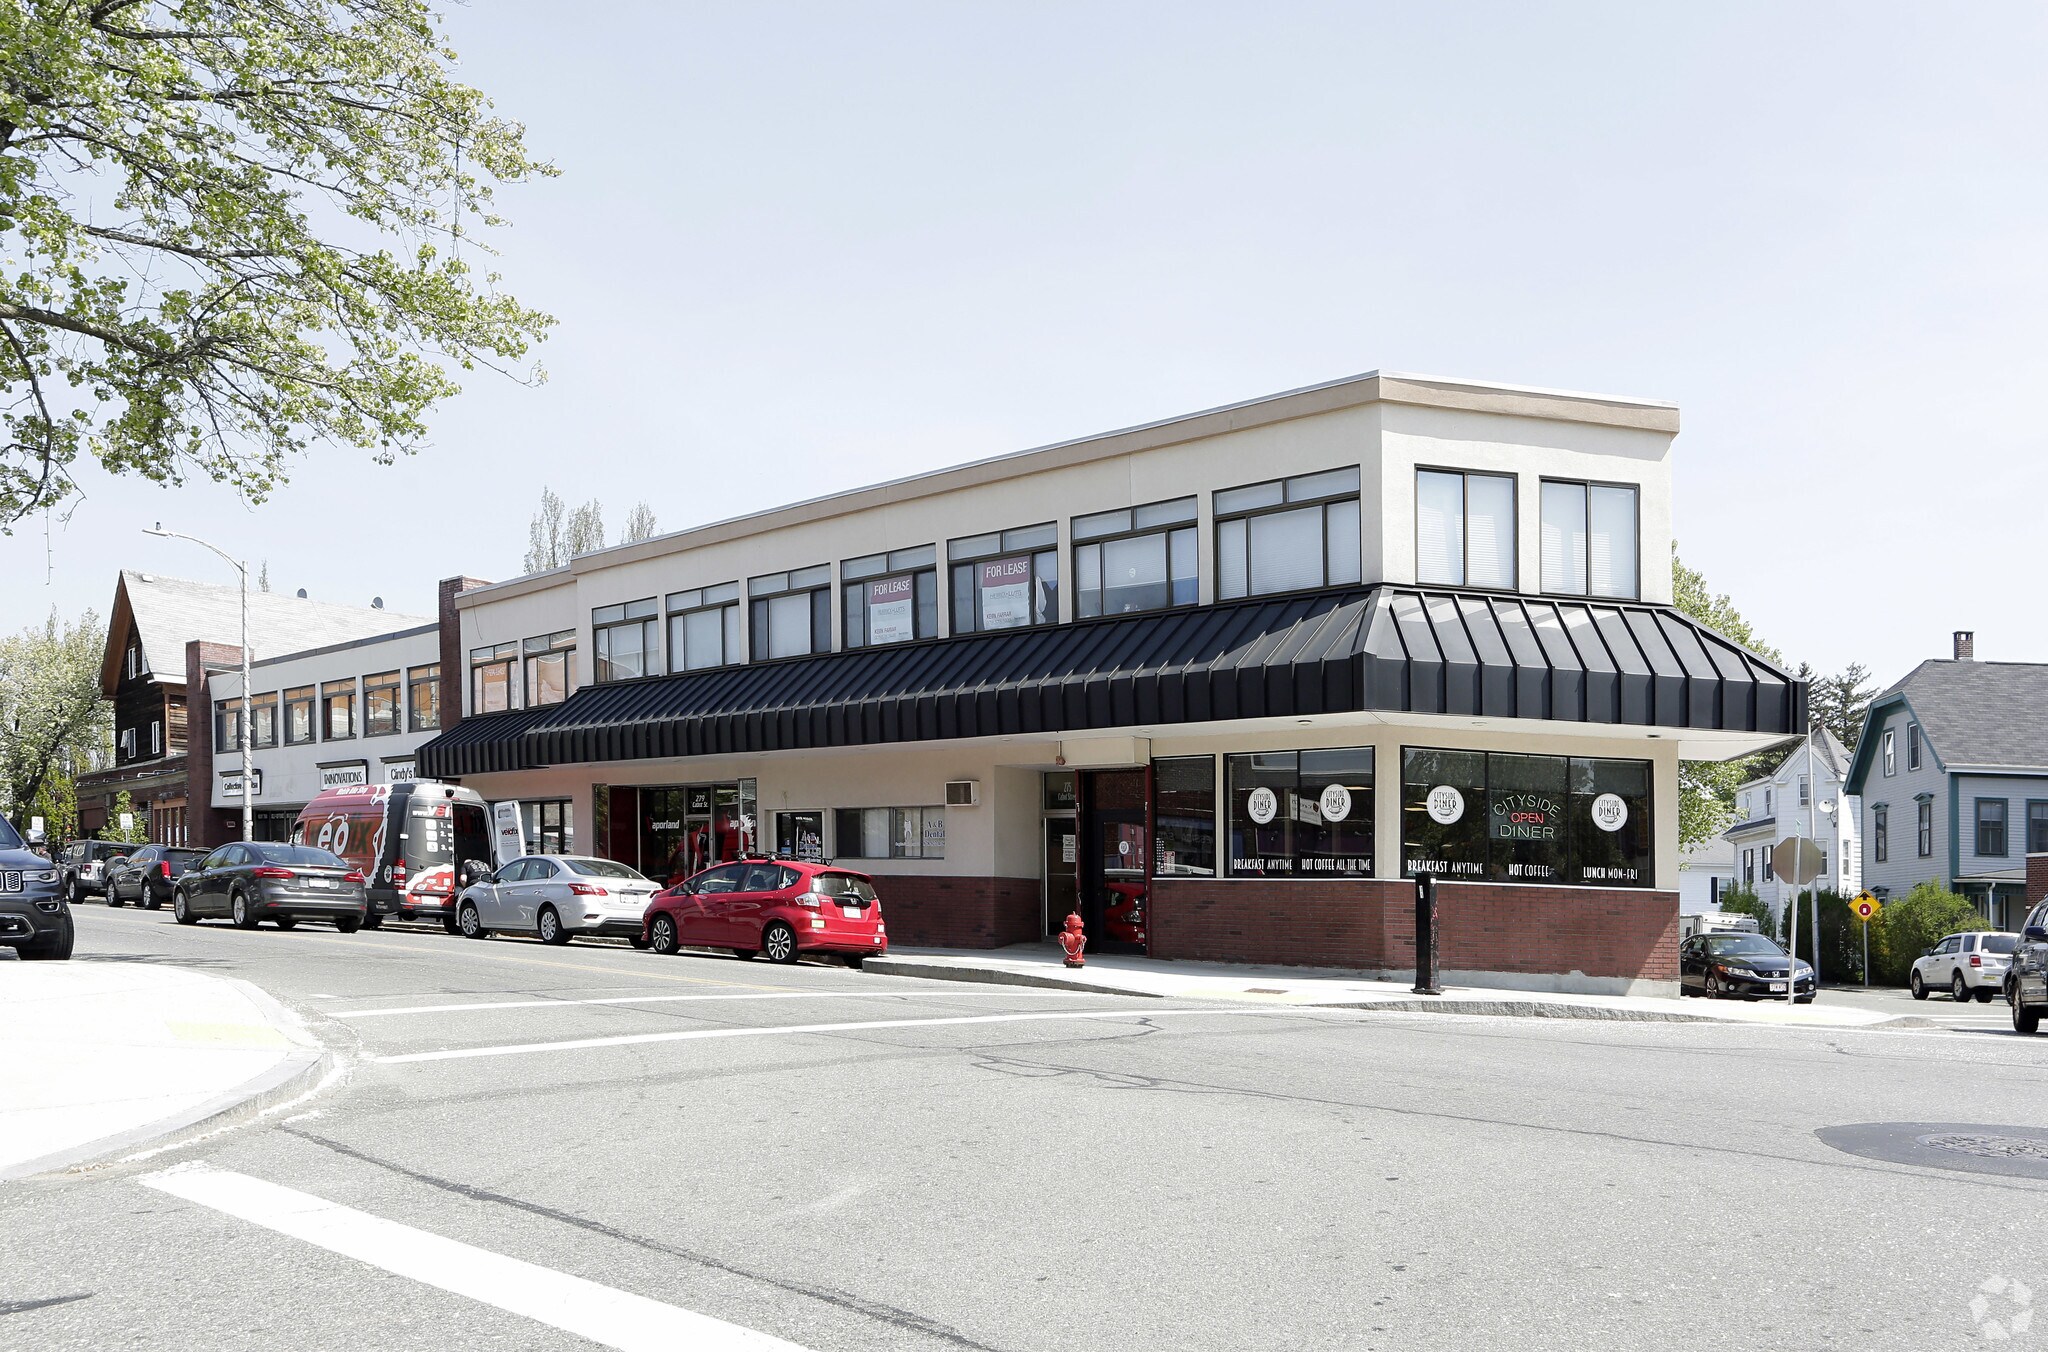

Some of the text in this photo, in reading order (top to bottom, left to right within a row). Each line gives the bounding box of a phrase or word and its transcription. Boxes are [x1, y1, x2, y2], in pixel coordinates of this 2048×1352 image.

[986, 561, 1028, 578] FOR LEASE
[874, 579, 910, 596] FOR LEASE
[323, 771, 363, 785] INNOVATIONS
[390, 767, 413, 782] Cindy's
[695, 794, 705, 802] 279
[1253, 793, 1271, 801] CITYSIDE
[1326, 790, 1345, 798] CITYSIDE
[1434, 791, 1456, 800] CITYSIDE
[1253, 800, 1272, 811] DINER
[1326, 797, 1346, 808] DINER
[1433, 798, 1457, 810] DINER
[1493, 794, 1561, 819] CITYSIDE
[1598, 798, 1620, 807] CITYSIDE
[1510, 812, 1544, 824] OPEN
[1598, 806, 1621, 819] DINER
[924, 830, 945, 838] Dental
[1499, 824, 1555, 840] DINER
[1233, 859, 1293, 870] BREAKFAST ANYTIME
[1301, 858, 1371, 871] HOT COFFEE ALL THE TIME
[1407, 859, 1484, 875] BREAKFAST ANYTIME
[1508, 863, 1550, 878] HOT COFFEE
[1583, 866, 1638, 880] LUNCH MON-FRI
